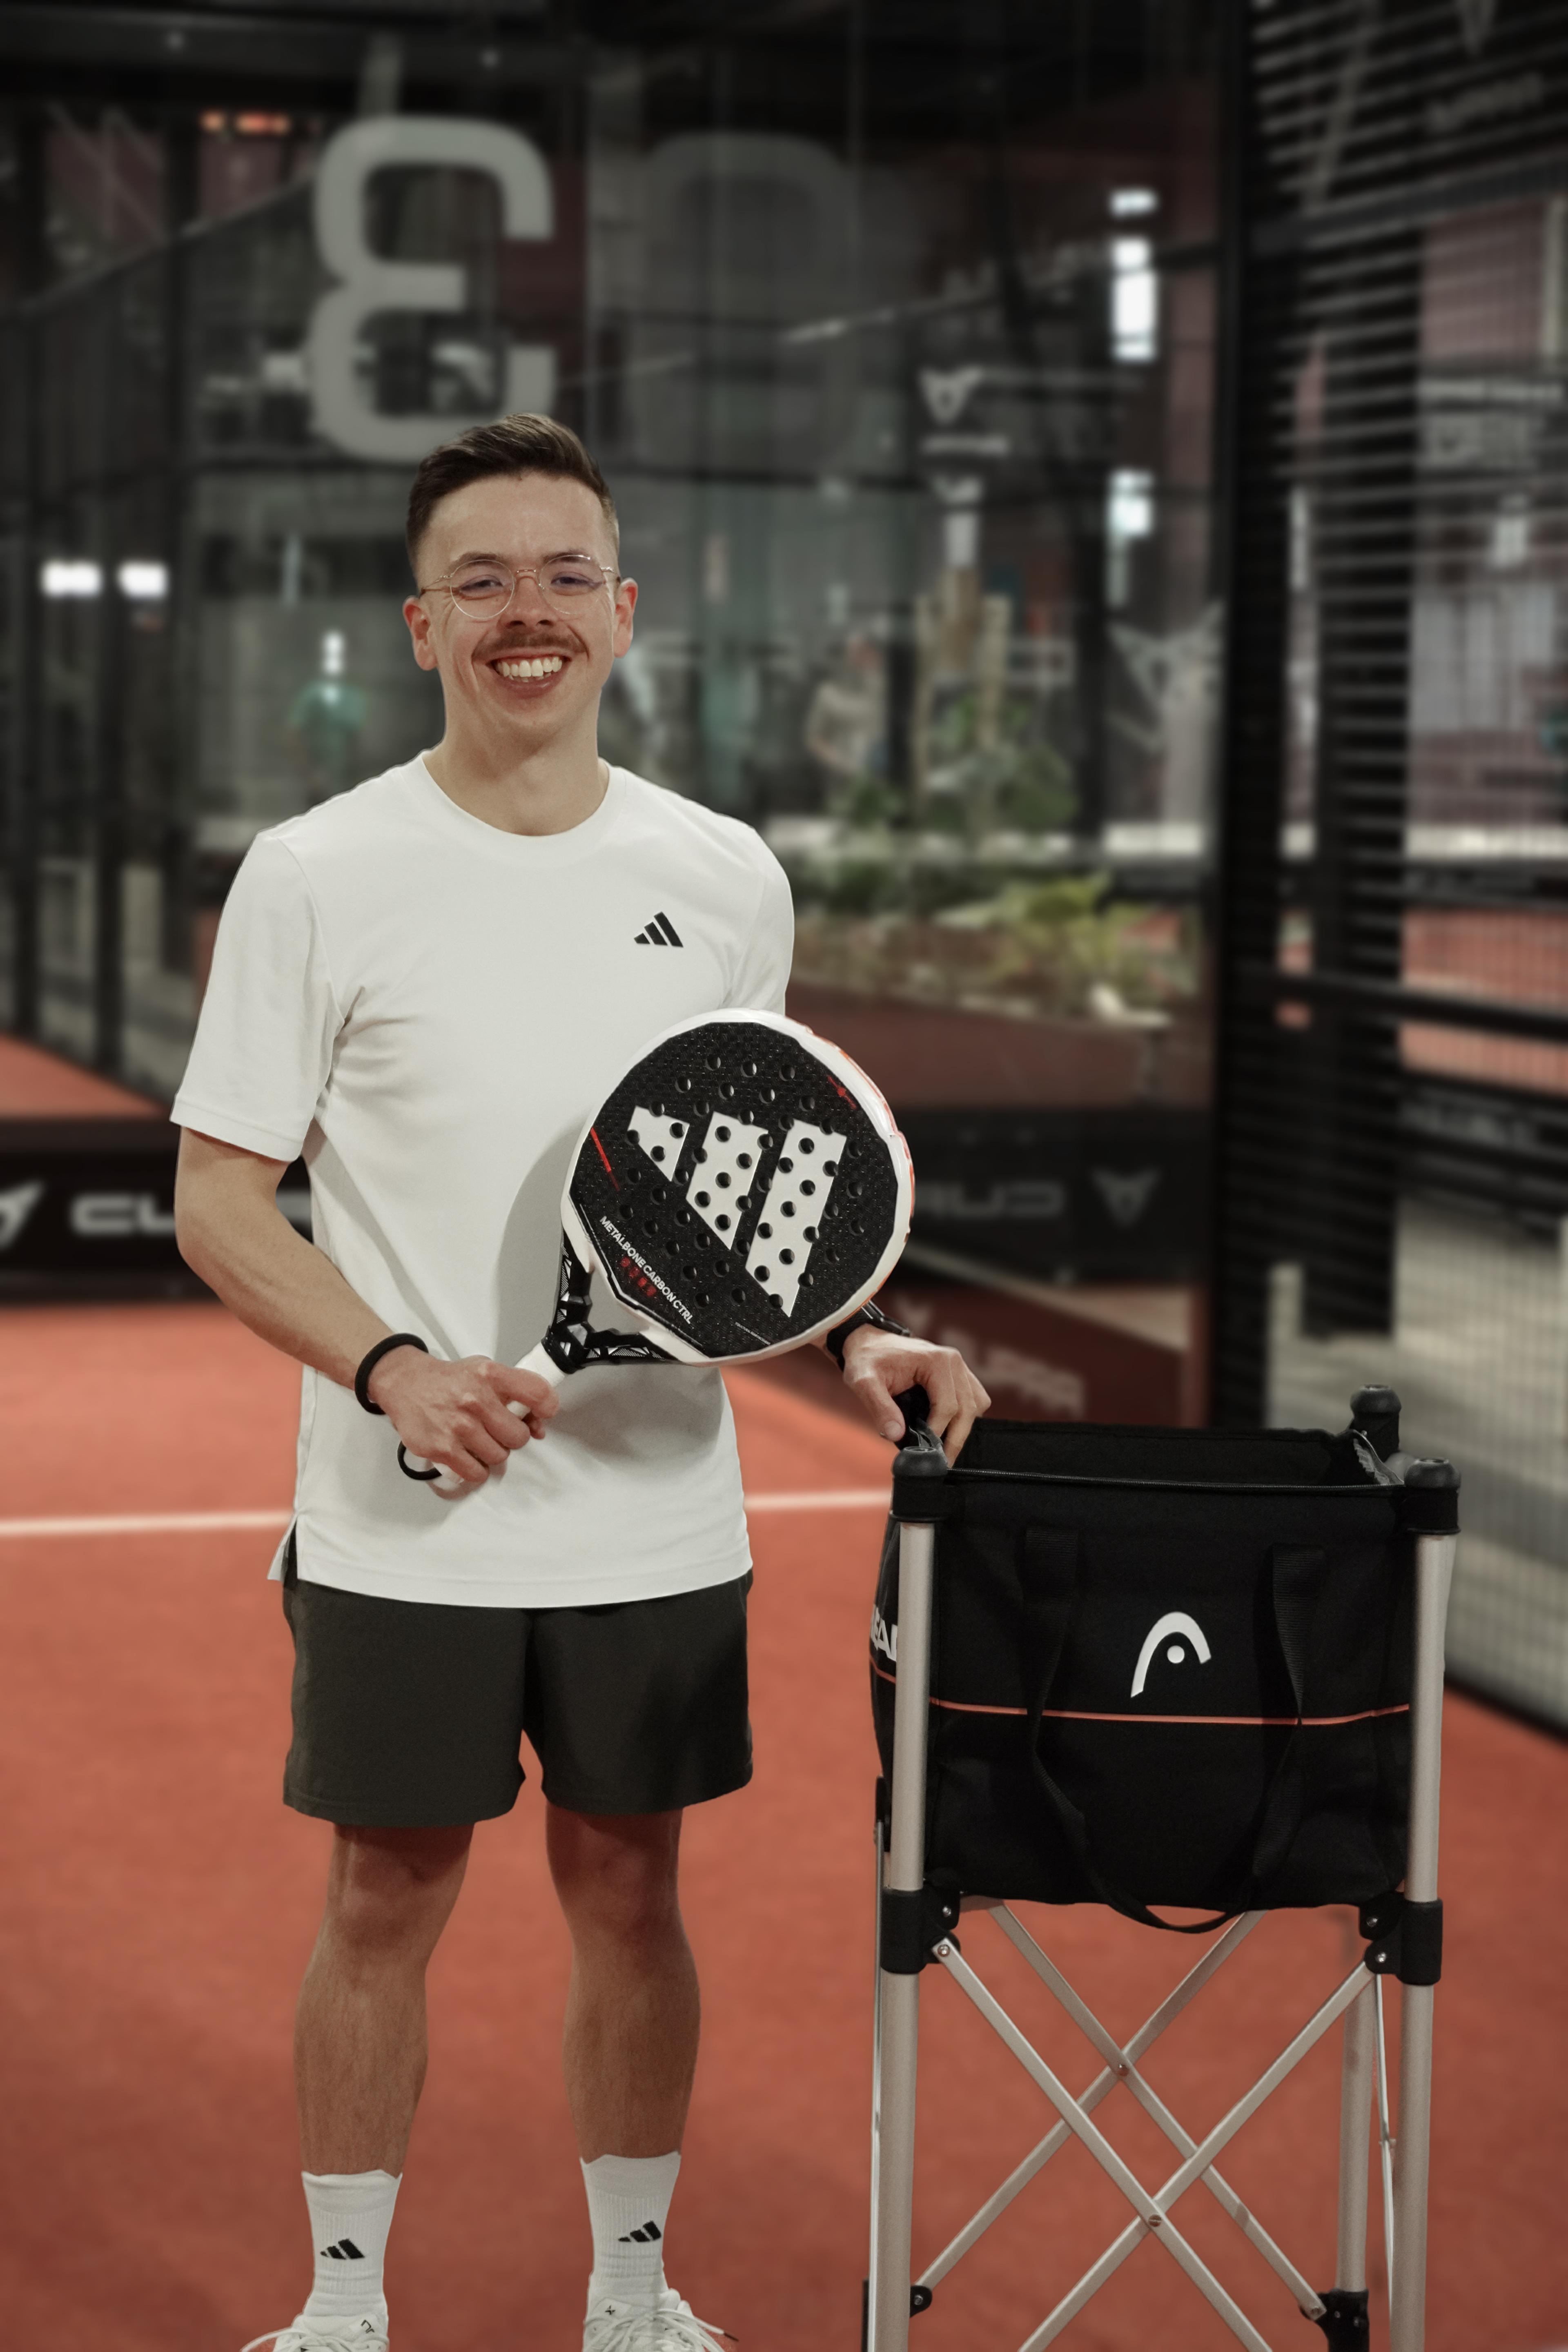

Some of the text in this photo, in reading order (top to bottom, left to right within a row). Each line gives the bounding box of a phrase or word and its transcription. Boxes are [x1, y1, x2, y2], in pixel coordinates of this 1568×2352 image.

[599, 1216, 693, 1325] METALBONE CARBON CTRL
